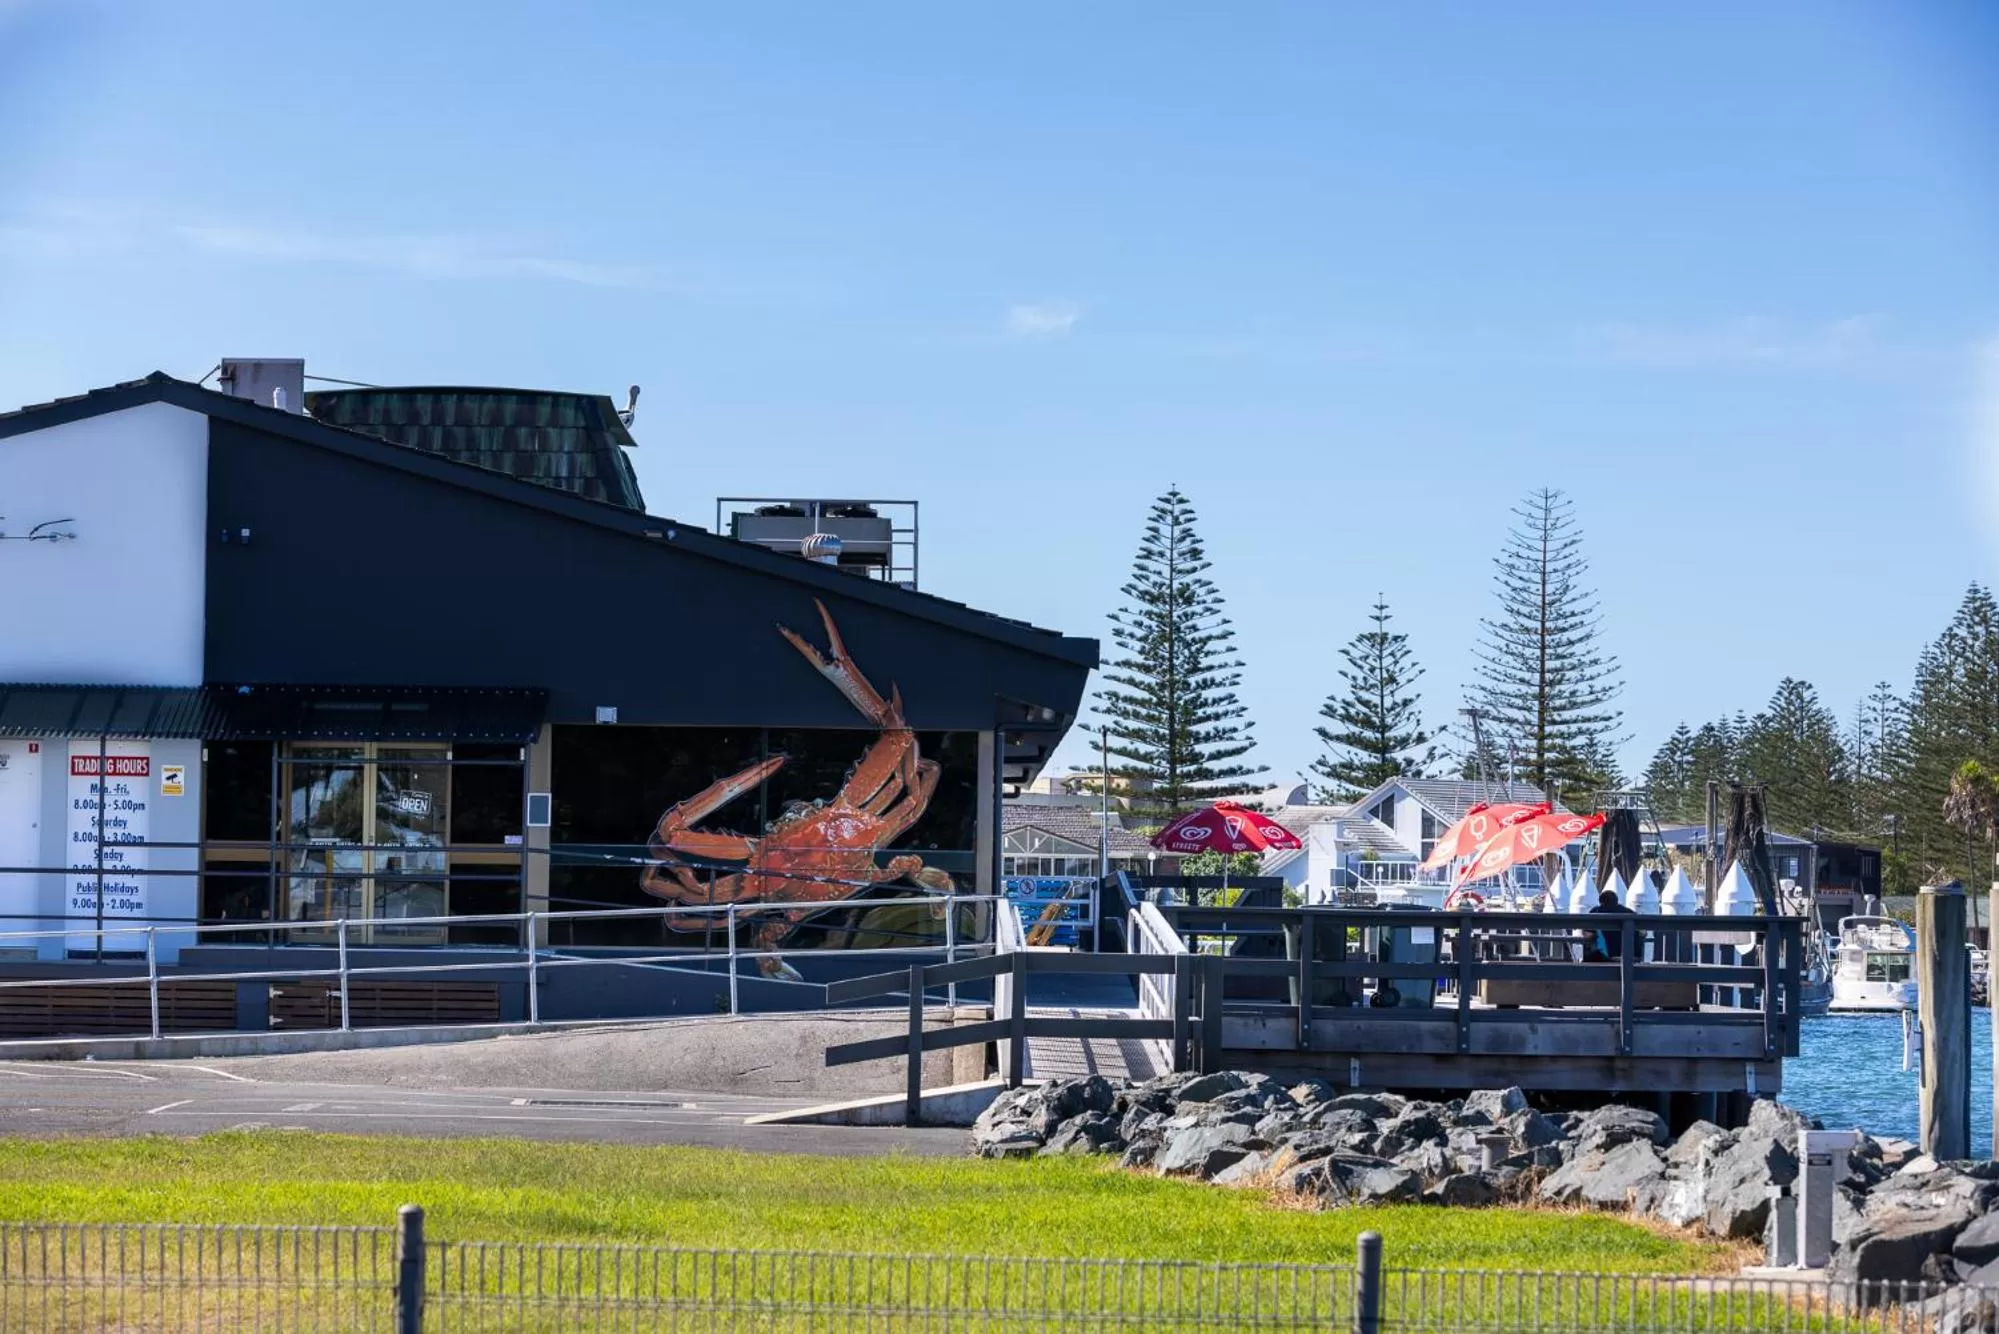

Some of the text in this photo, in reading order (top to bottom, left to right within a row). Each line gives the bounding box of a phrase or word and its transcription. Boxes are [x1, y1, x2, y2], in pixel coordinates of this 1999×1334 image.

[116, 759, 148, 774] HOURS
[90, 783, 111, 794] Mn.
[74, 799, 106, 810] 8.00a
[113, 799, 146, 813] 5.00pm
[402, 797, 428, 812] OPEN
[91, 816, 128, 830] Saurday
[73, 831, 106, 842] 8.00a
[93, 848, 124, 862] Snday
[76, 881, 139, 896] Publi Holidays
[72, 898, 104, 909] 9.00a
[110, 898, 144, 912] 2.00pm
